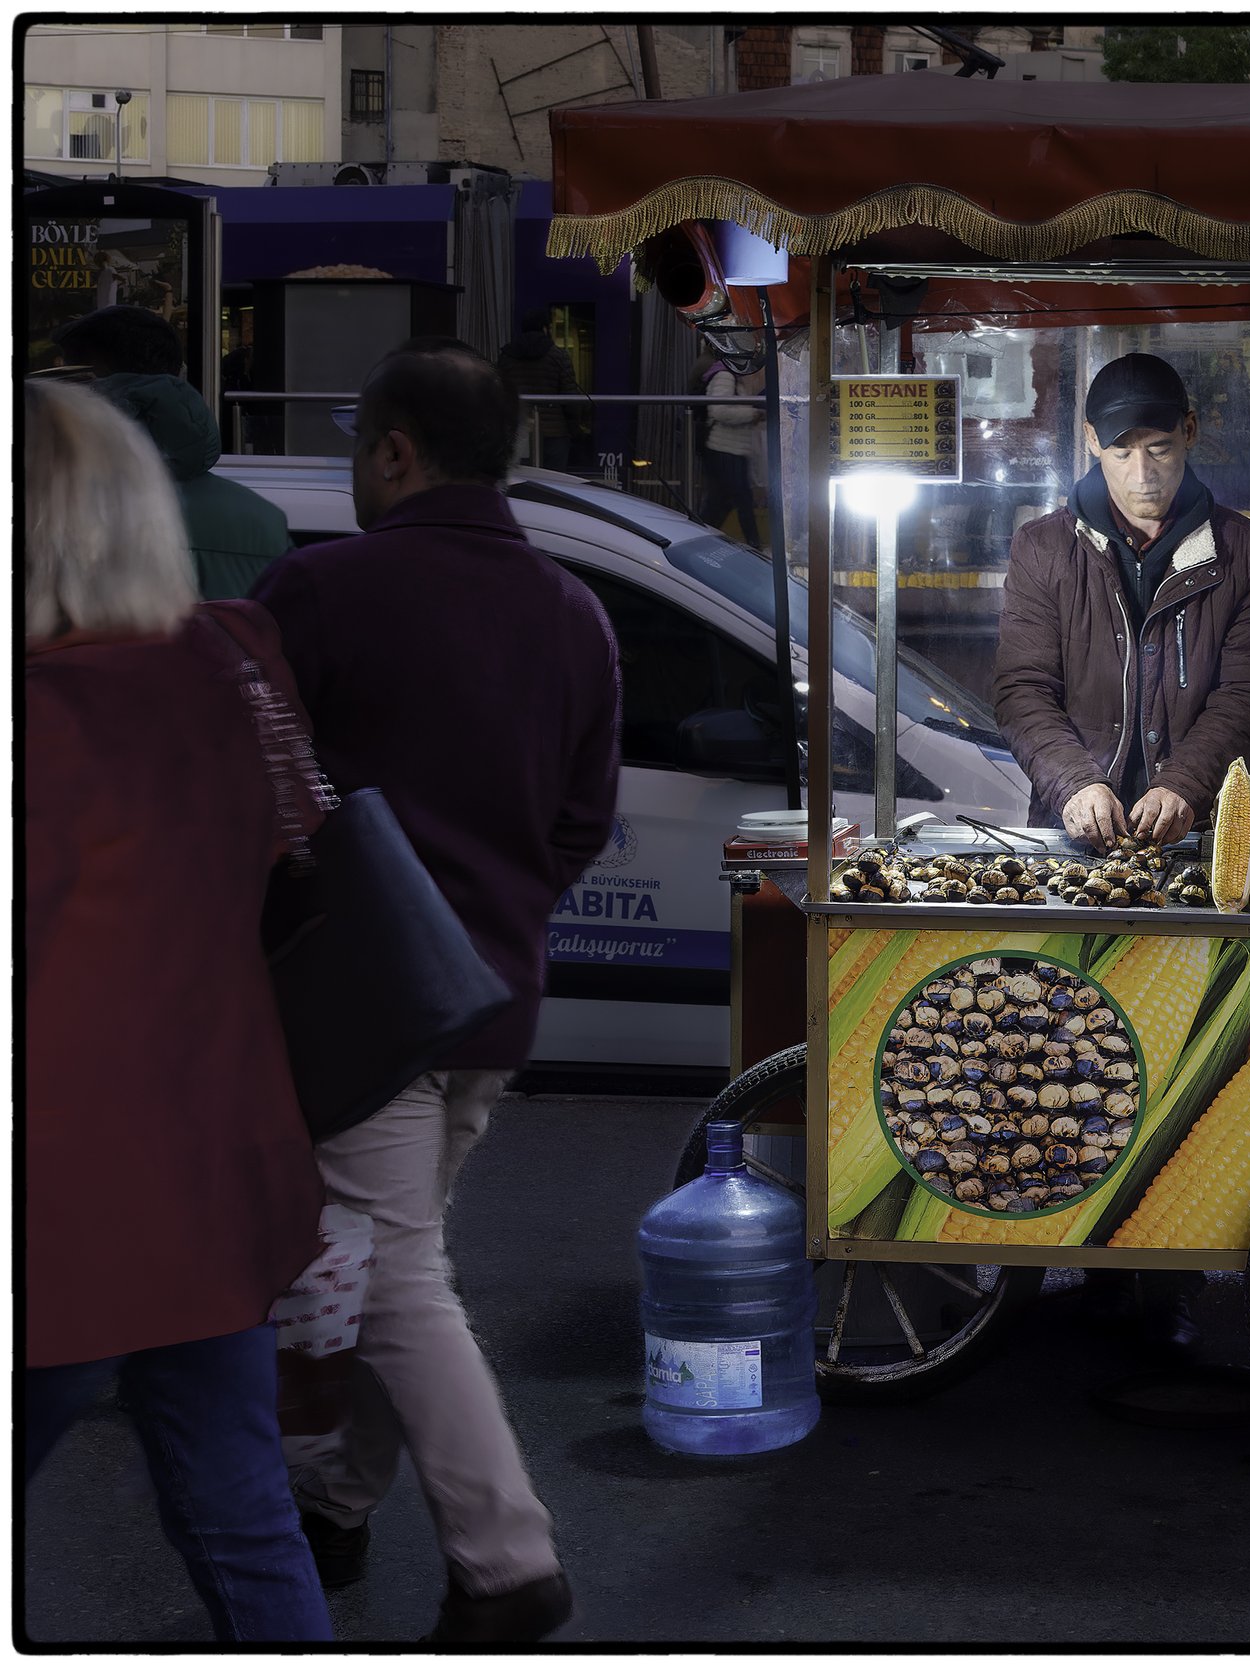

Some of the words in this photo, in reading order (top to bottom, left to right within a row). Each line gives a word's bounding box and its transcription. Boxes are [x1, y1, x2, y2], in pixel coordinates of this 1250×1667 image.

[31, 220, 98, 243] BÖYLE
[31, 265, 98, 289] GÜZEL
[848, 384, 928, 398] KESTANE
[598, 453, 623, 467] 701
[746, 848, 799, 859] Electronic
[591, 874, 661, 890] BÜYÜKŞEHİR
[555, 888, 658, 922] ABITA
